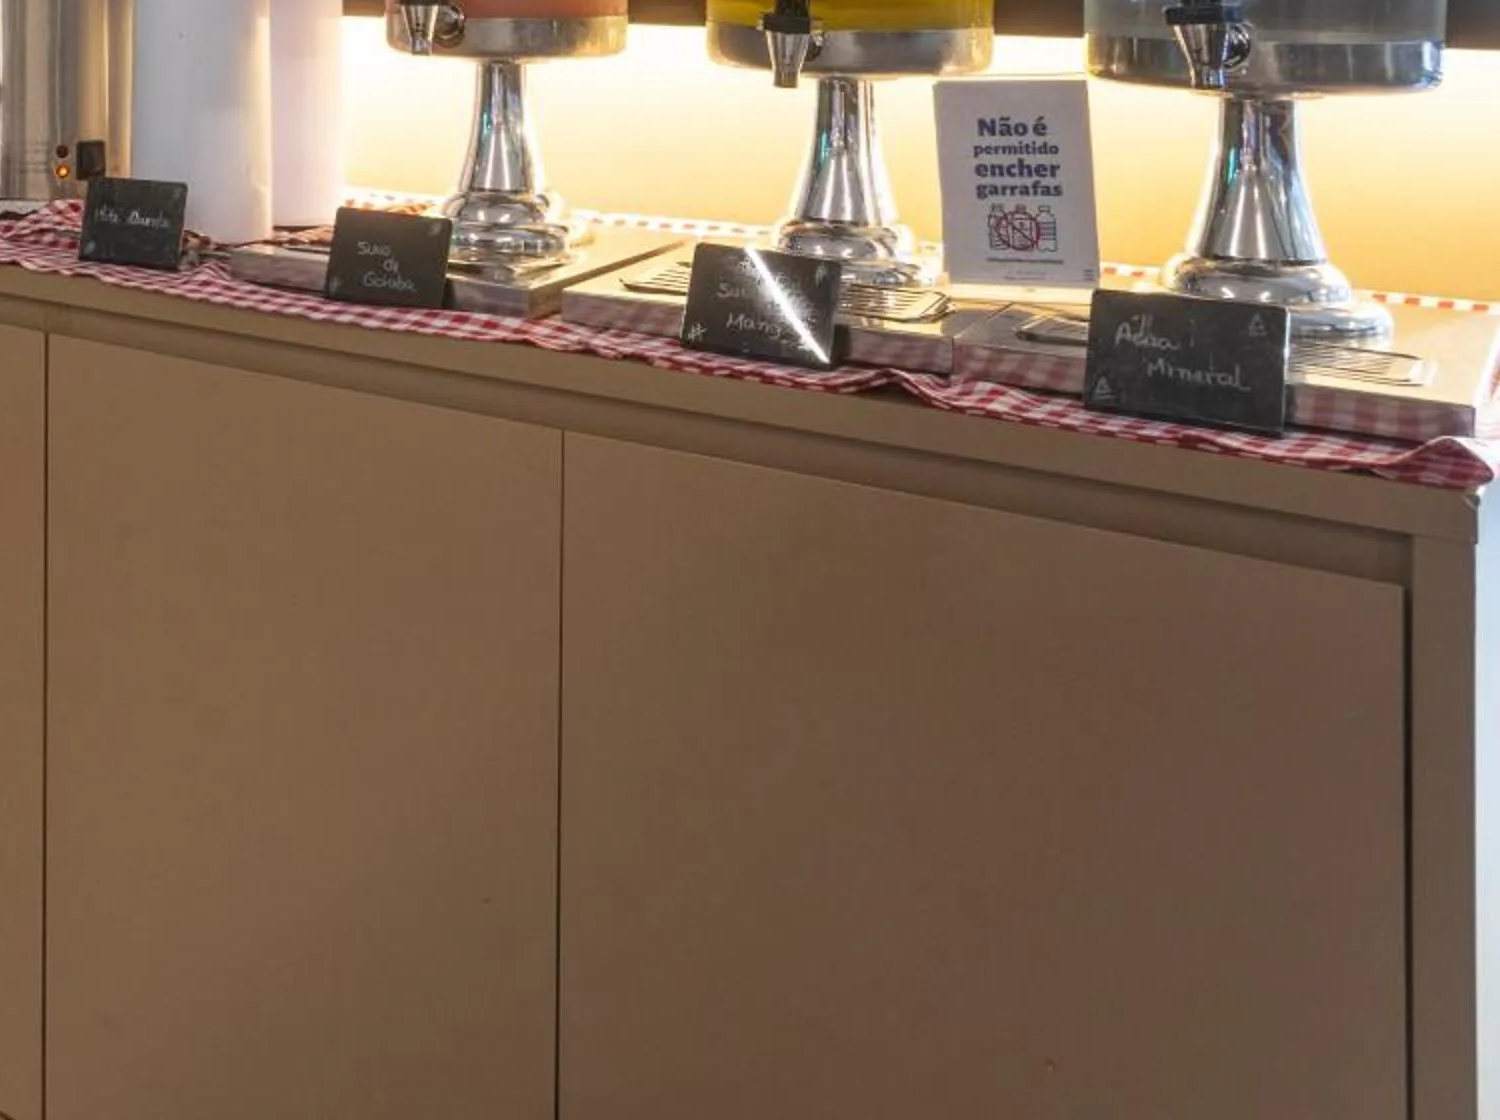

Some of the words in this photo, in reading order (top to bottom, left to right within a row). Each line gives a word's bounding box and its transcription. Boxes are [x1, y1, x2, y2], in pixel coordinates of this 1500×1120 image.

[977, 116, 1029, 137] Não
[1033, 116, 1048, 136] é
[973, 141, 1059, 158] permitido
[974, 158, 1060, 178] encher
[976, 180, 1063, 199] garrafas
